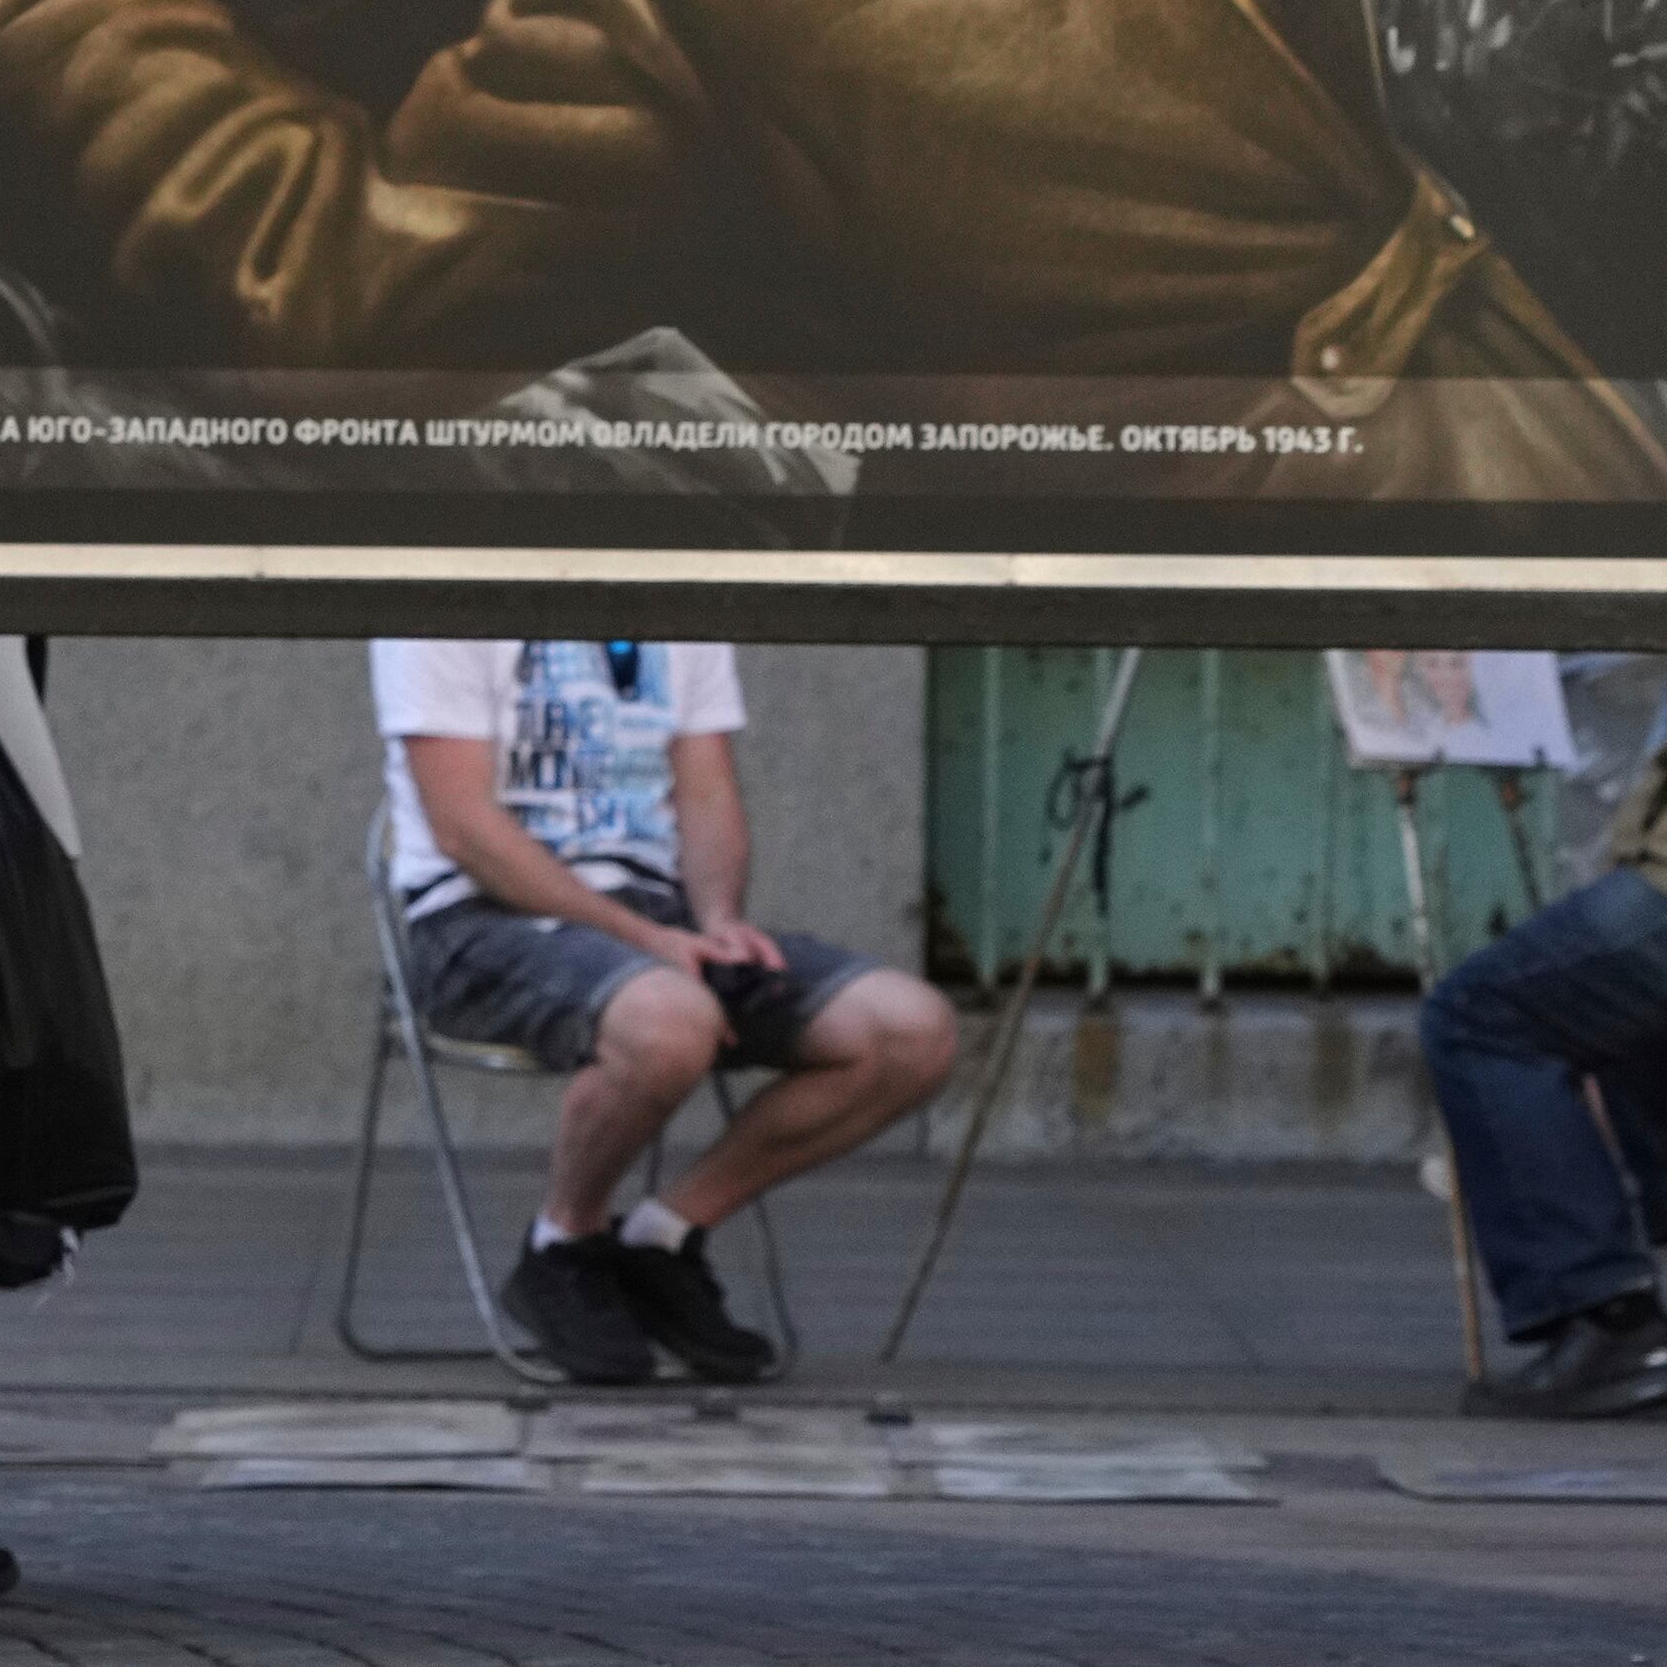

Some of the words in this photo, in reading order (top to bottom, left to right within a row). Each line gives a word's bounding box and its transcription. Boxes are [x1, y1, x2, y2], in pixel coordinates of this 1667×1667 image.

[27, 416, 288, 446] ЮГО-ЗАПАДНОГО
[294, 418, 419, 446] ФРОНТА
[425, 419, 585, 446] ШТУРМОМ
[591, 420, 758, 451] ОВЛАДЕЛИ
[766, 422, 914, 452] ГОРОДОМ
[920, 424, 1115, 452] ЗАПОРОЖЬЕ.
[1120, 425, 1257, 453] ОКТЯБРЬ
[1265, 426, 1331, 454] 1943
